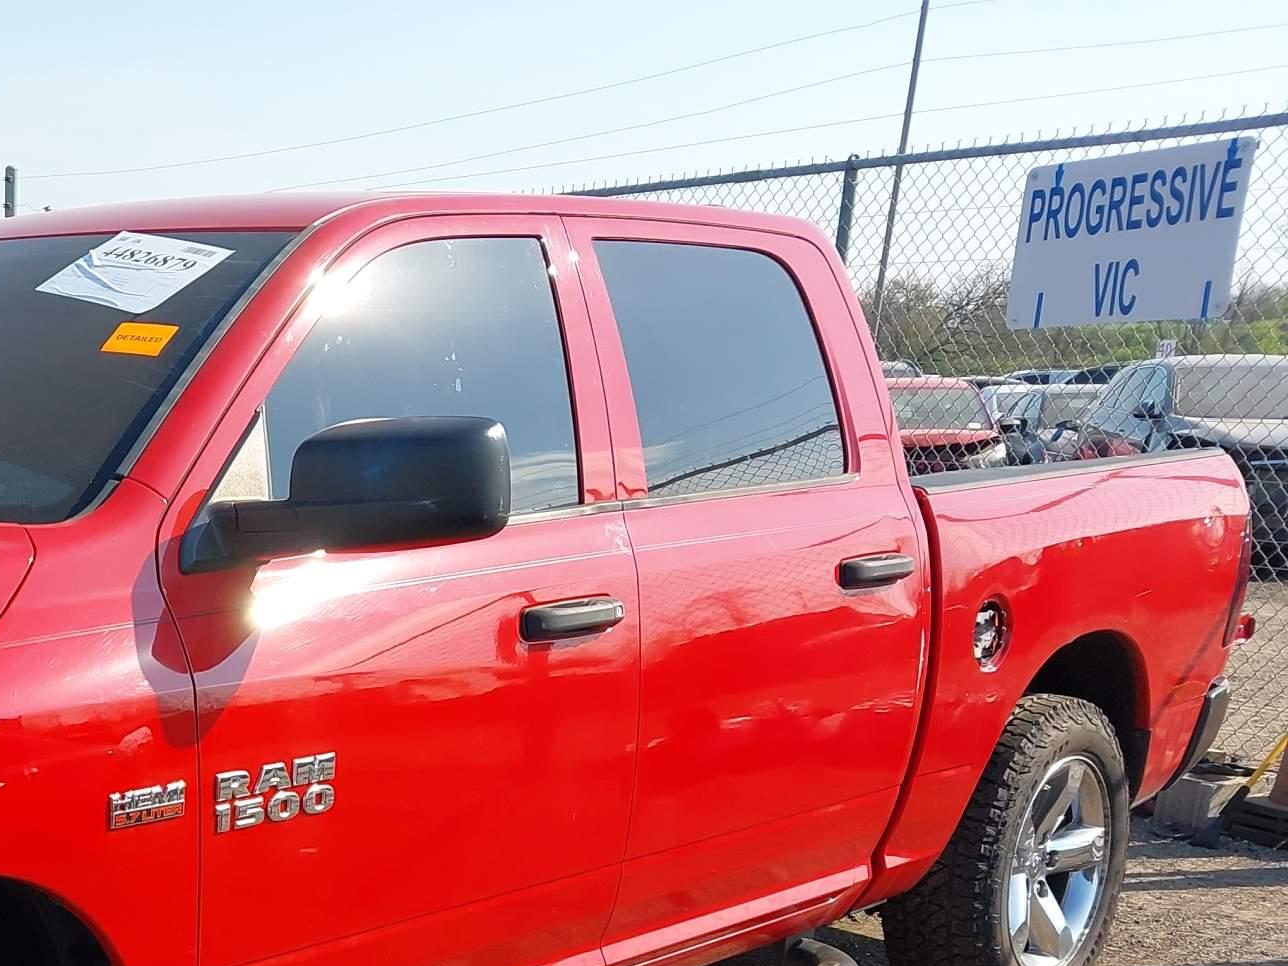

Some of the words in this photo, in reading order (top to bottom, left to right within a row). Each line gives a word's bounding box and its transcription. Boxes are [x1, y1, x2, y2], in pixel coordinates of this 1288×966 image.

[1025, 158, 1243, 244] PROGRESSIVE
[103, 246, 198, 272] 44826879
[1094, 258, 1141, 318] VIC
[115, 333, 163, 344] DETAILED
[109, 779, 187, 813] HEMI
[215, 751, 336, 802] RAM
[114, 811, 140, 826] 5.7
[141, 805, 183, 822] LITER
[215, 783, 335, 834] 1500
